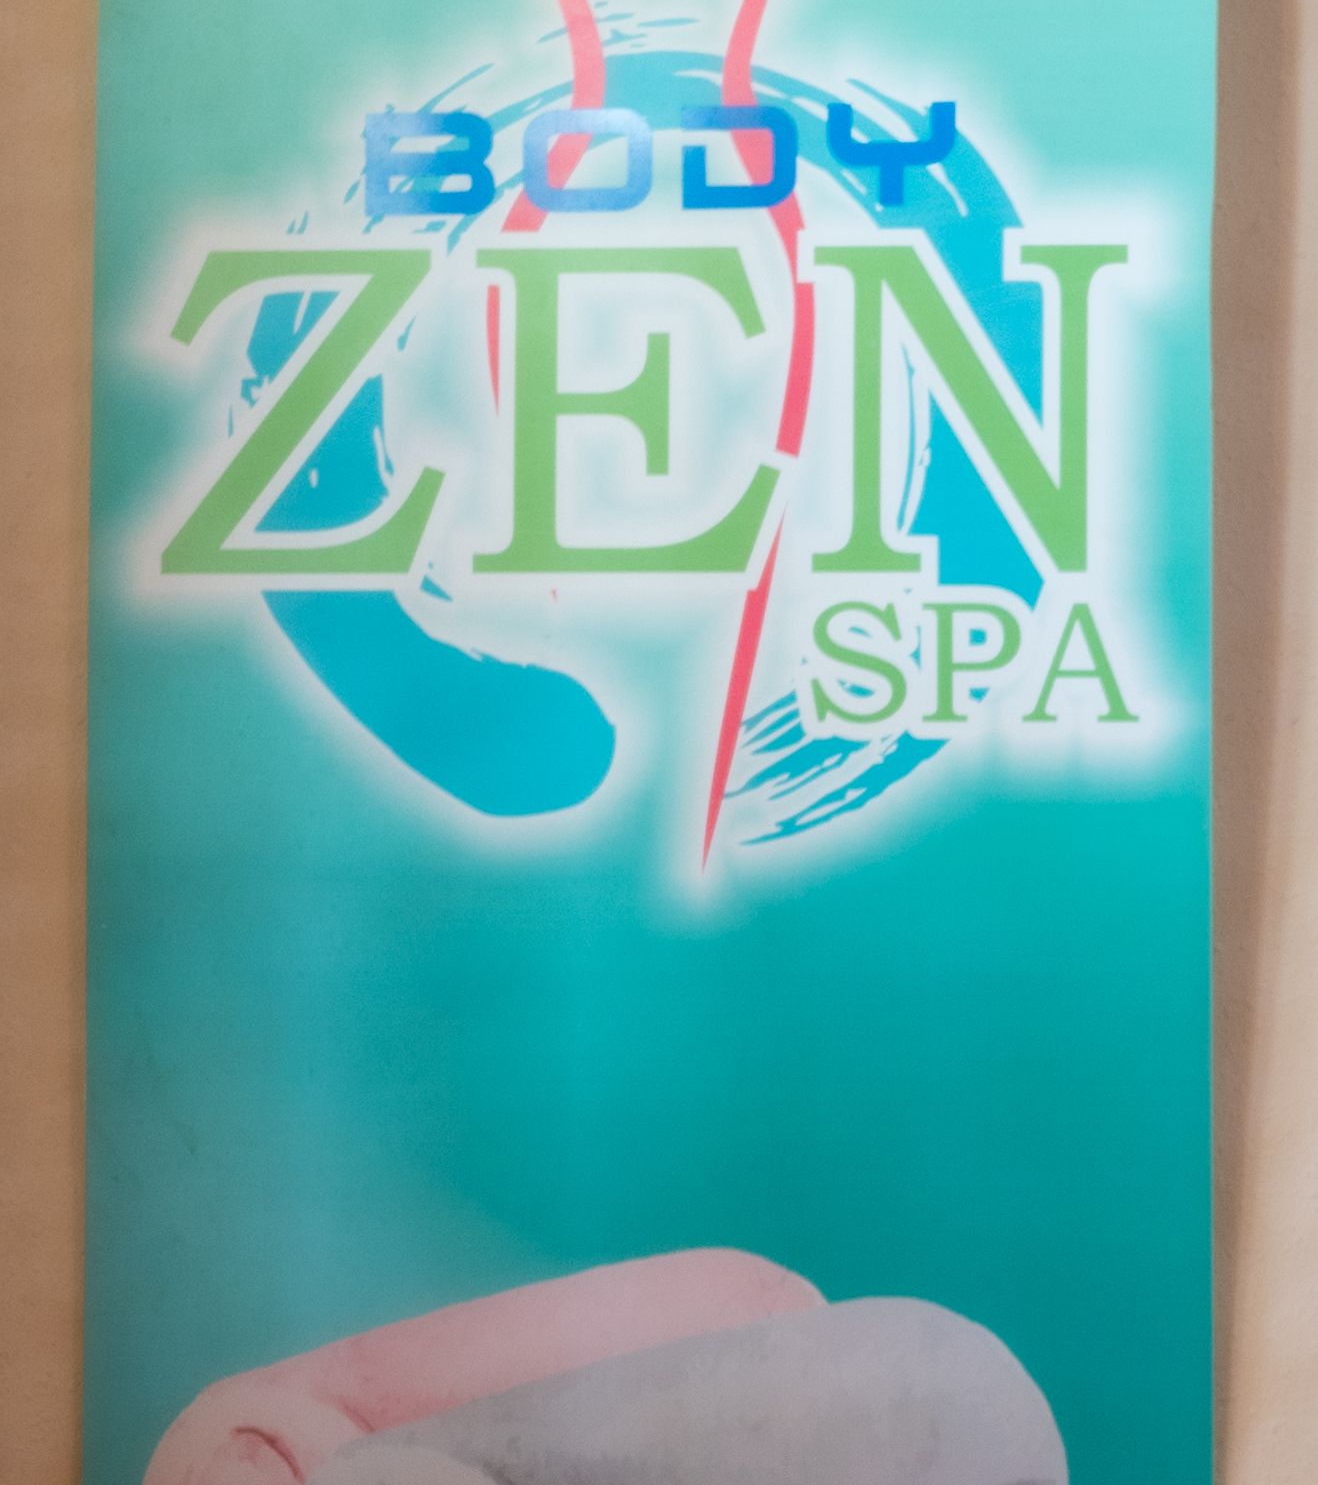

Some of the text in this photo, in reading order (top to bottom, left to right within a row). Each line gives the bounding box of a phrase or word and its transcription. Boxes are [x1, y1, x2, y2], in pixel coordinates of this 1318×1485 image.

[362, 100, 957, 217] BODY
[160, 244, 1128, 575] ZEN
[808, 600, 1140, 724] SPA
